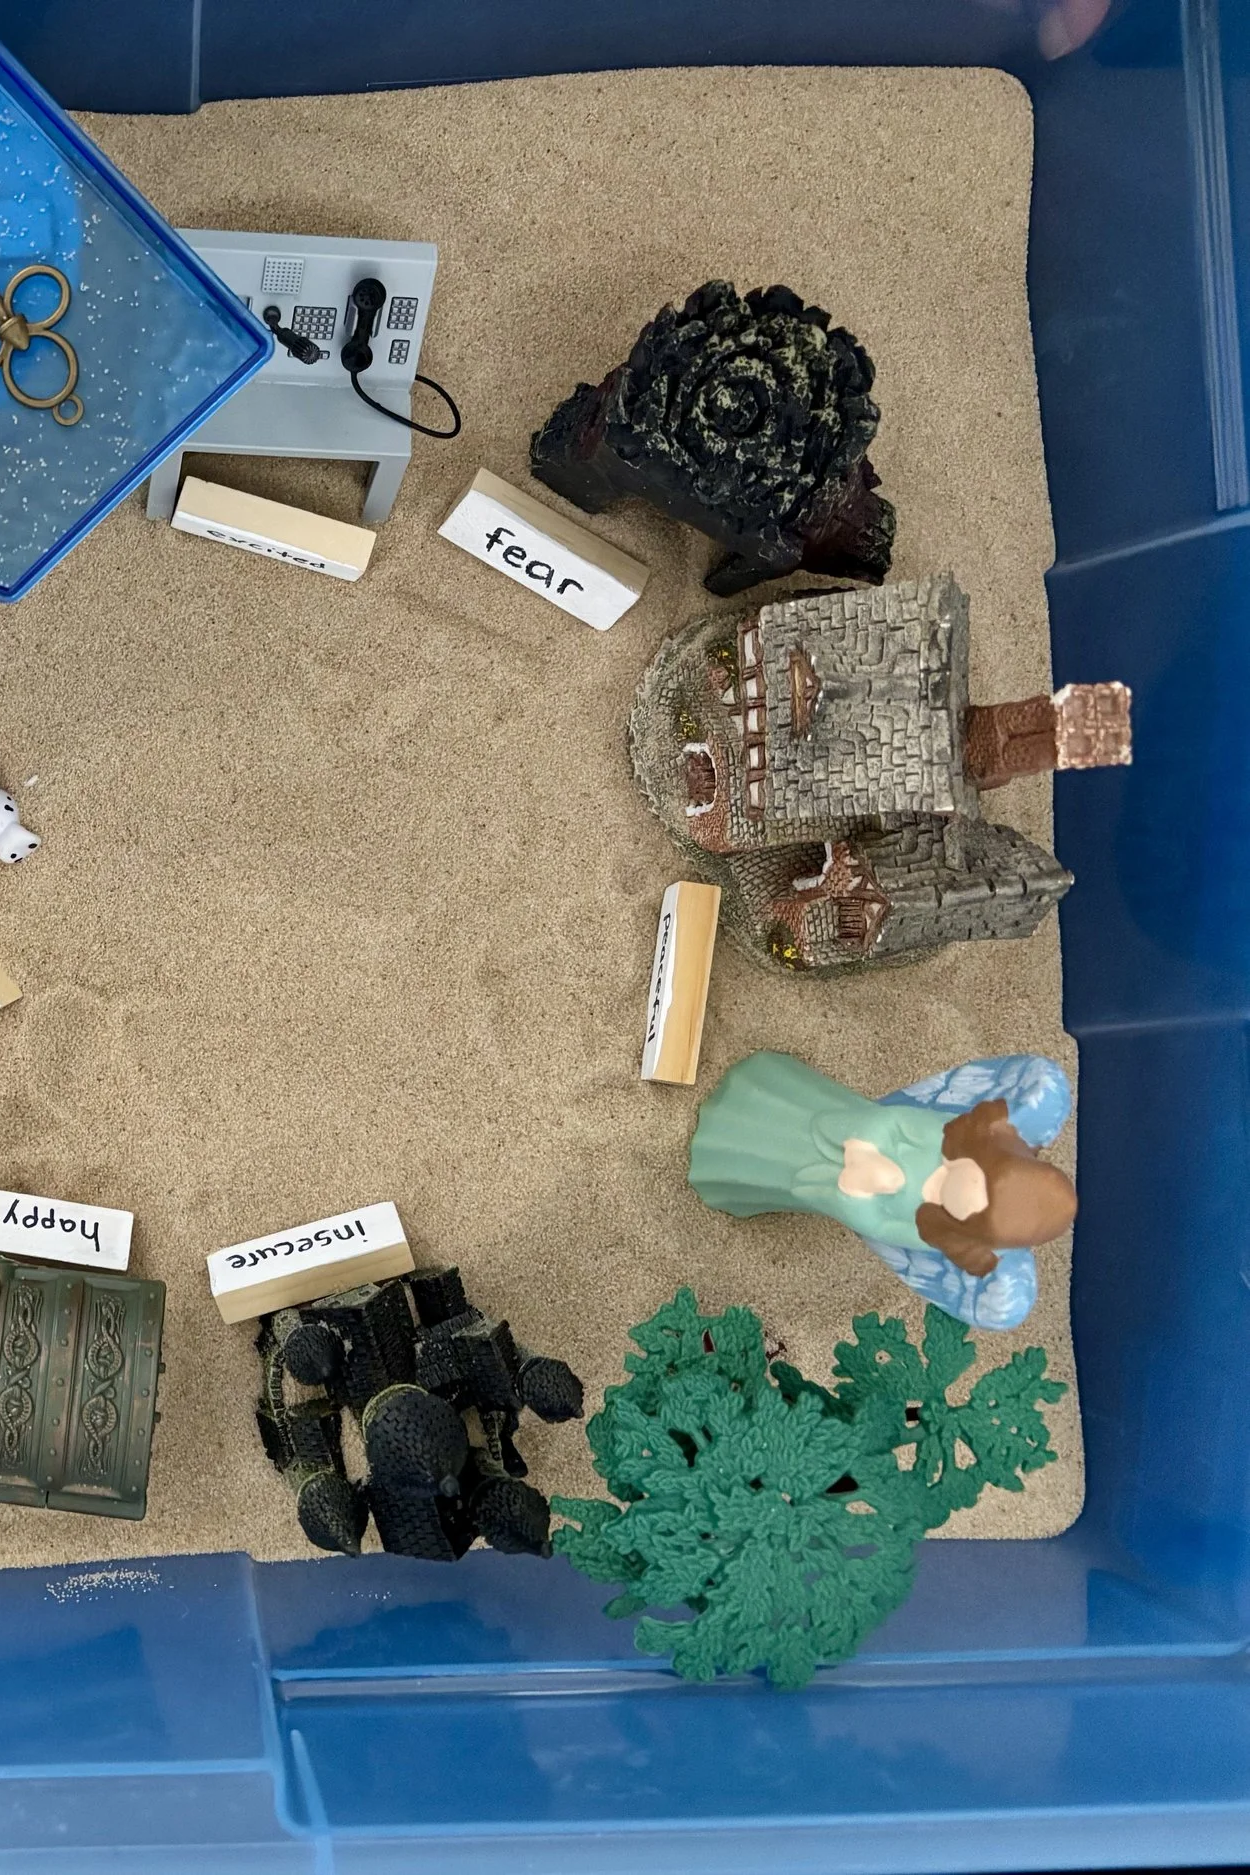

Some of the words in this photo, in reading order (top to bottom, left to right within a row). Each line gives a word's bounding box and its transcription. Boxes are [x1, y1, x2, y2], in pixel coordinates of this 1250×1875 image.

[207, 528, 325, 569] excited
[485, 527, 584, 595] fear
[647, 912, 672, 1043] peaceful
[3, 1199, 100, 1253] happy
[226, 1220, 368, 1269] insecure
